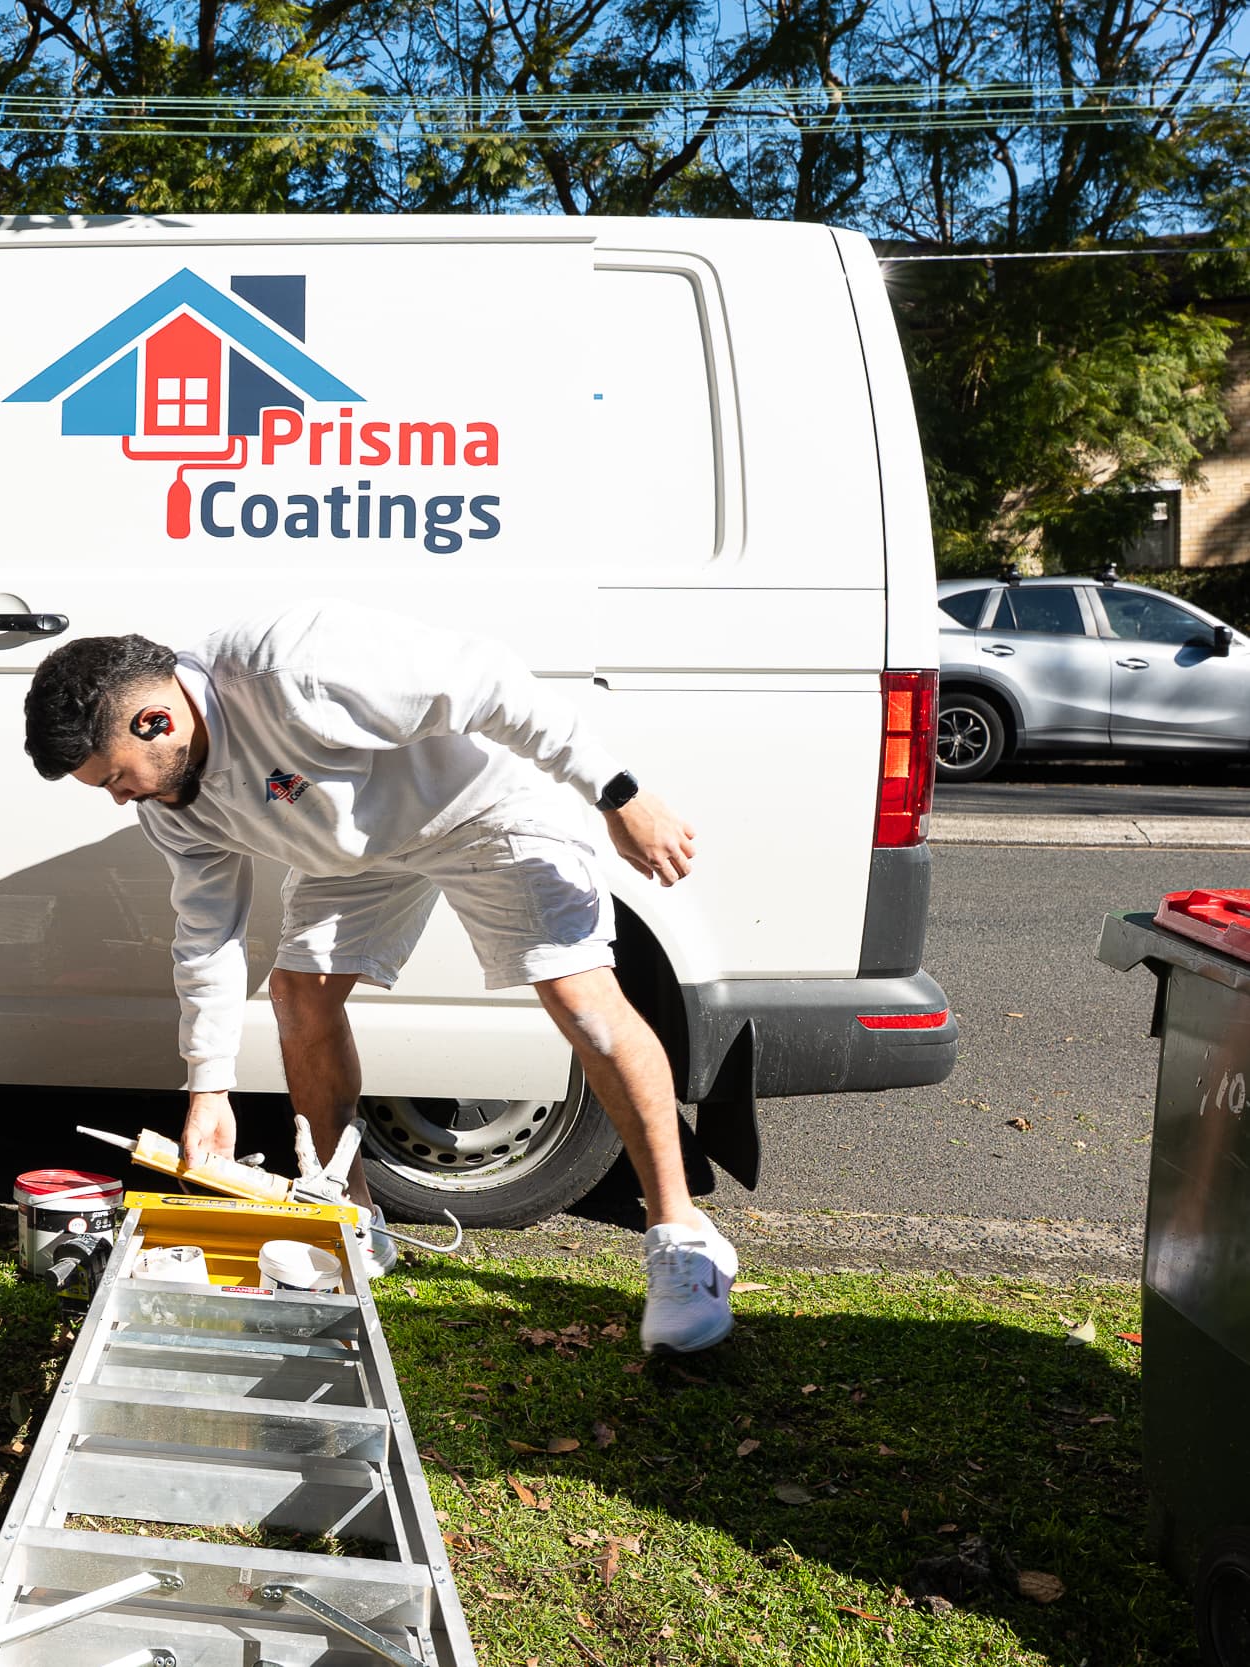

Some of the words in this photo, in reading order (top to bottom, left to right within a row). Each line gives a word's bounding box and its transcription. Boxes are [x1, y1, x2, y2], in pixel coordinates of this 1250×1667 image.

[260, 407, 499, 467] Prisma
[199, 480, 501, 555] Coatings
[229, 1287, 265, 1295] DANGER
